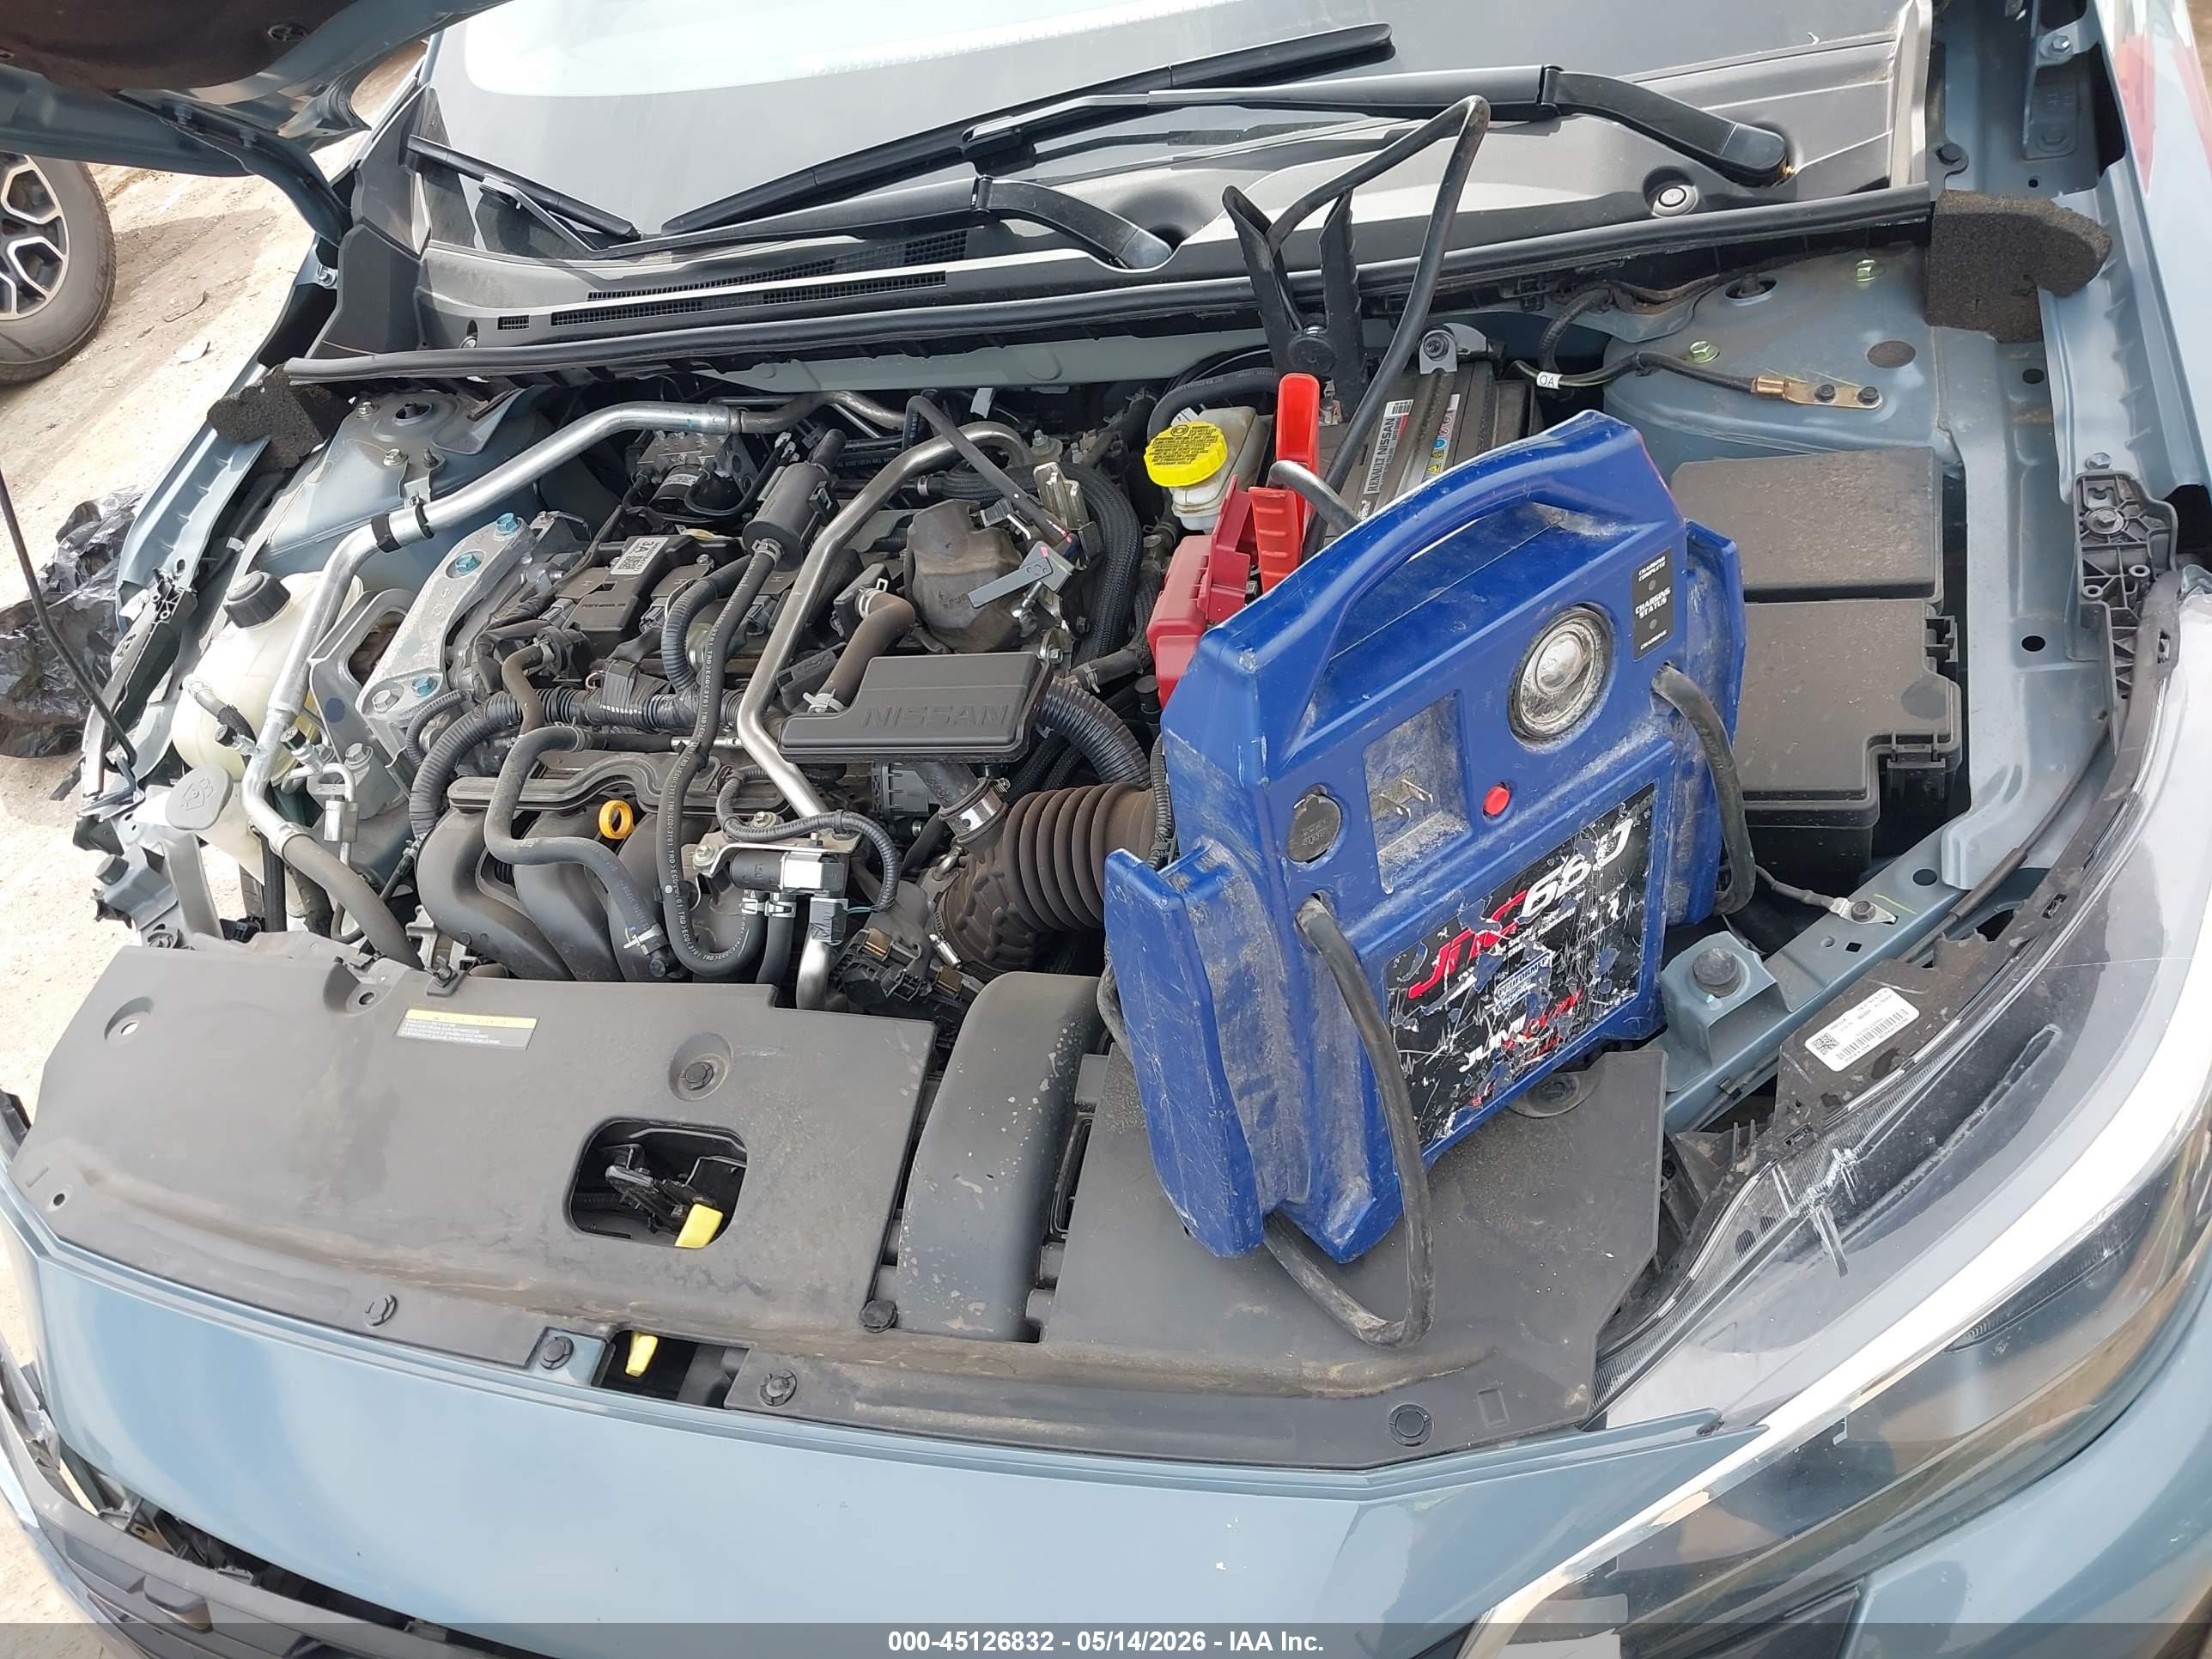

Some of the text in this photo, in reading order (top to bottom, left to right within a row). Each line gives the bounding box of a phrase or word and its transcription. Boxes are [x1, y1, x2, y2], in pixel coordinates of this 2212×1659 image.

[1367, 457, 1385, 492] RENAULT
[1378, 417, 1396, 456] NISSAN
[1638, 561, 1667, 583] COMPLETE
[1635, 586, 1671, 615] CHARGING
[1638, 597, 1668, 619] STATUS
[860, 704, 1010, 728] NISSAN
